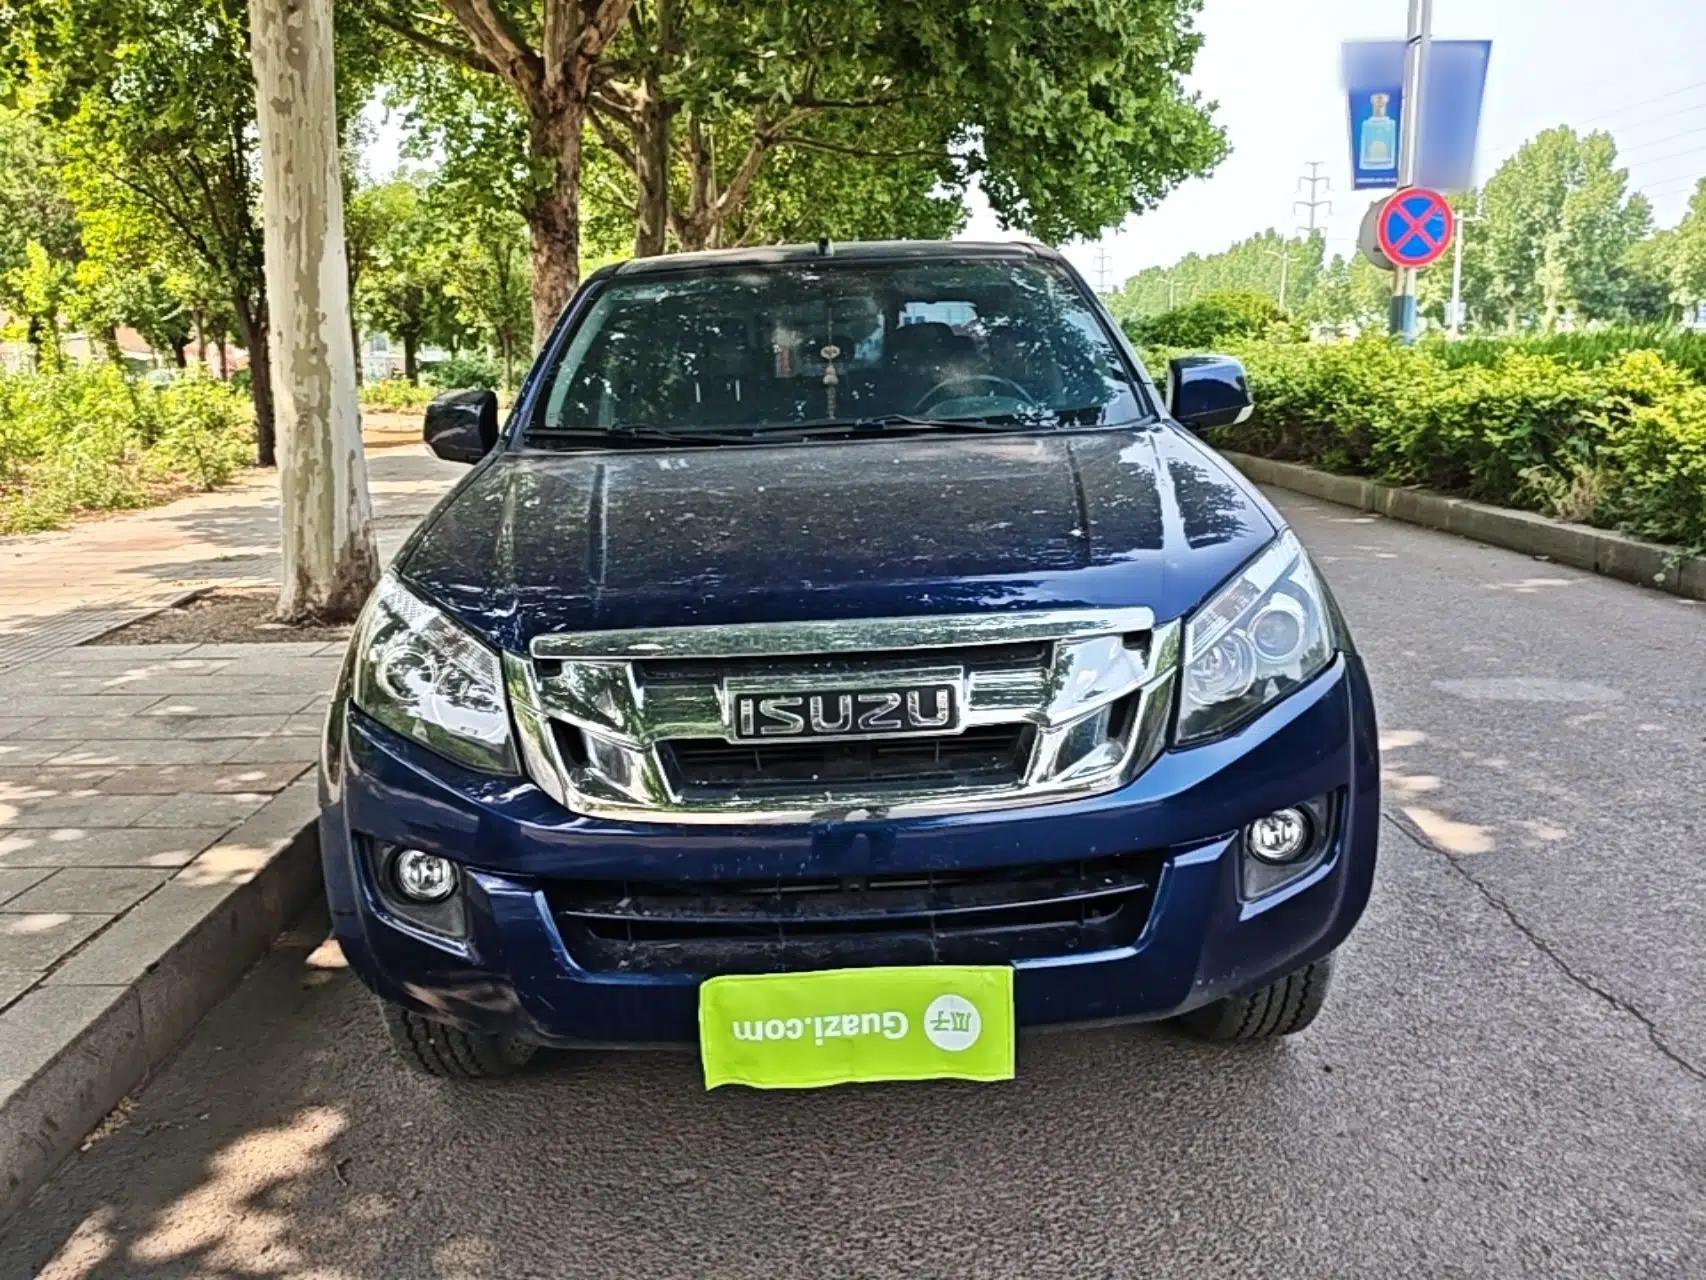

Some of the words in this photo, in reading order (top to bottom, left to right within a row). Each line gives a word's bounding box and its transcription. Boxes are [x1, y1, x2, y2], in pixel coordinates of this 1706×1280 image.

[740, 689, 949, 736] ISUZU
[732, 1010, 909, 1046] Guazi.com
[929, 1010, 971, 1033] 瓜子
